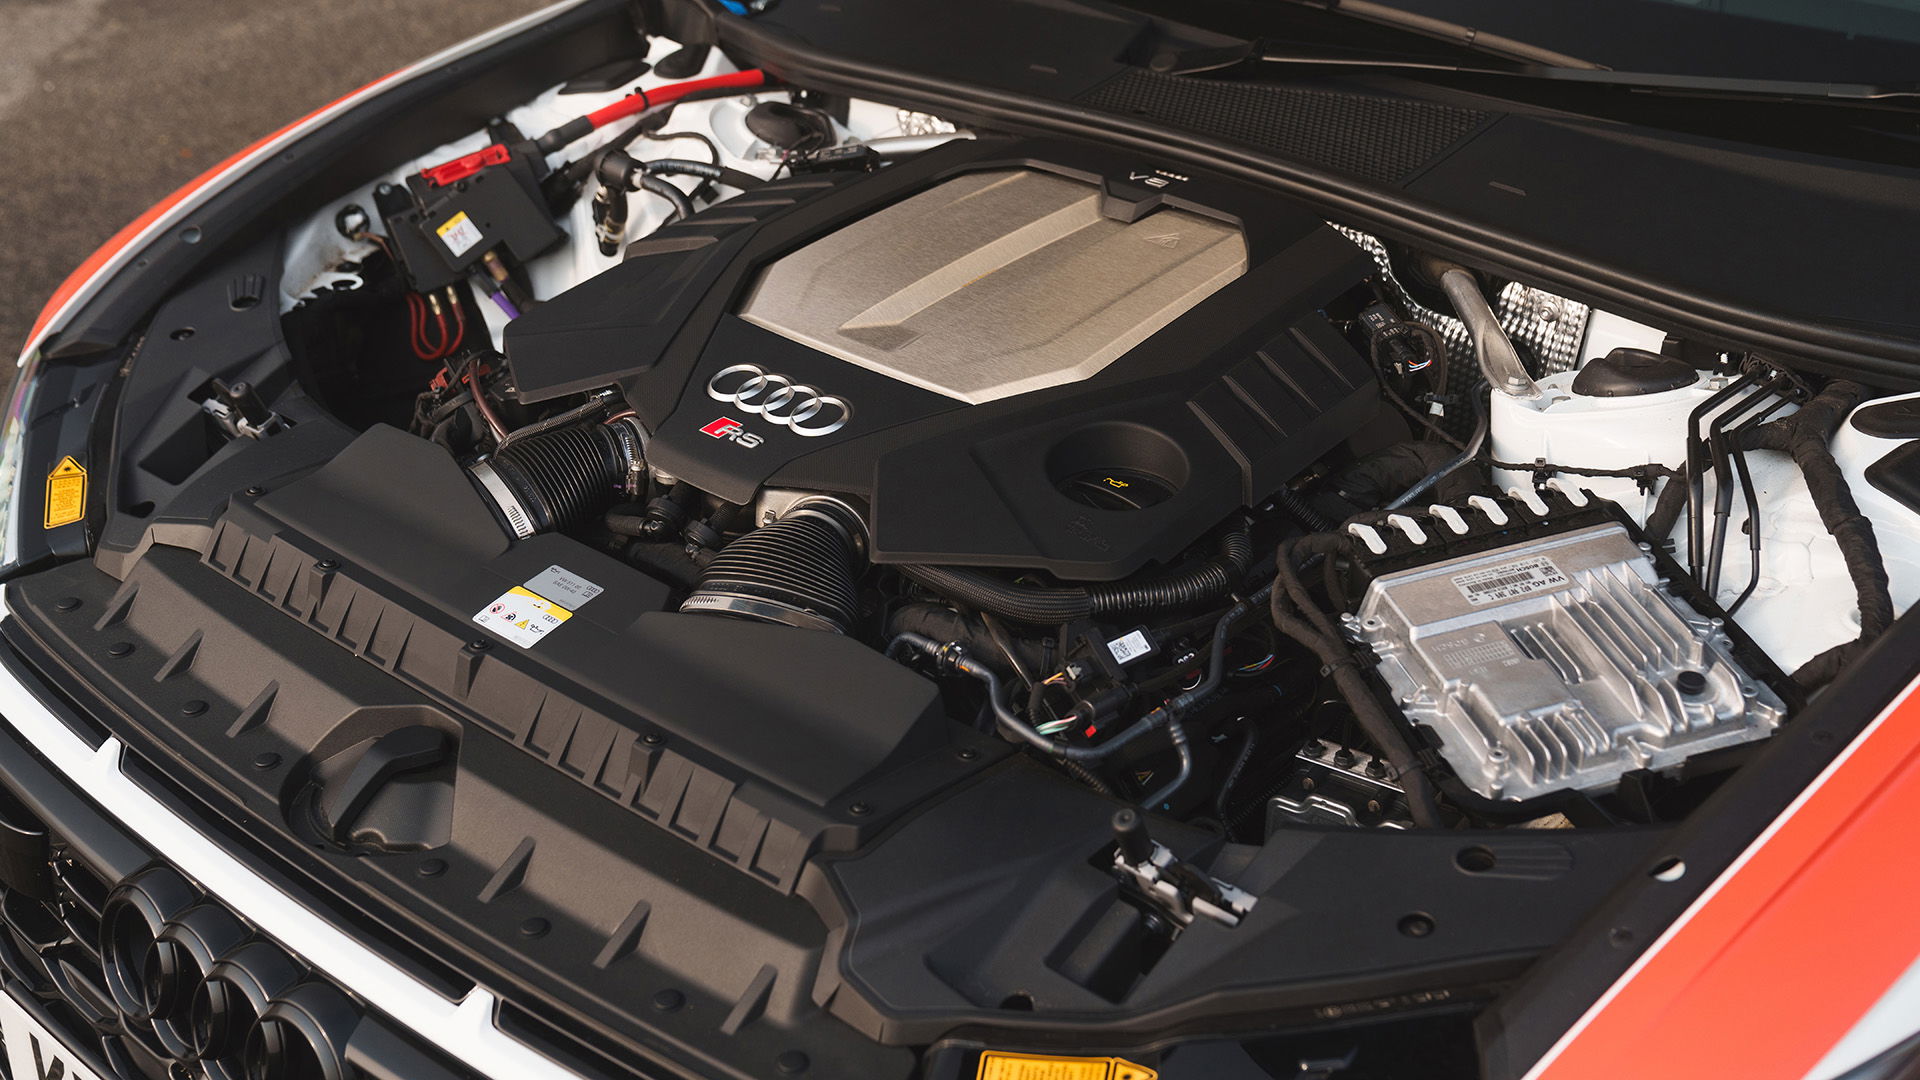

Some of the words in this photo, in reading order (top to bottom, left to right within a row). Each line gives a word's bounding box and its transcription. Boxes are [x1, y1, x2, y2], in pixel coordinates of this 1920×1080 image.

[708, 421, 765, 449] RS
[1516, 563, 1539, 573] BOSCH
[1532, 579, 1546, 588] AG
[1548, 575, 1565, 584] VW
